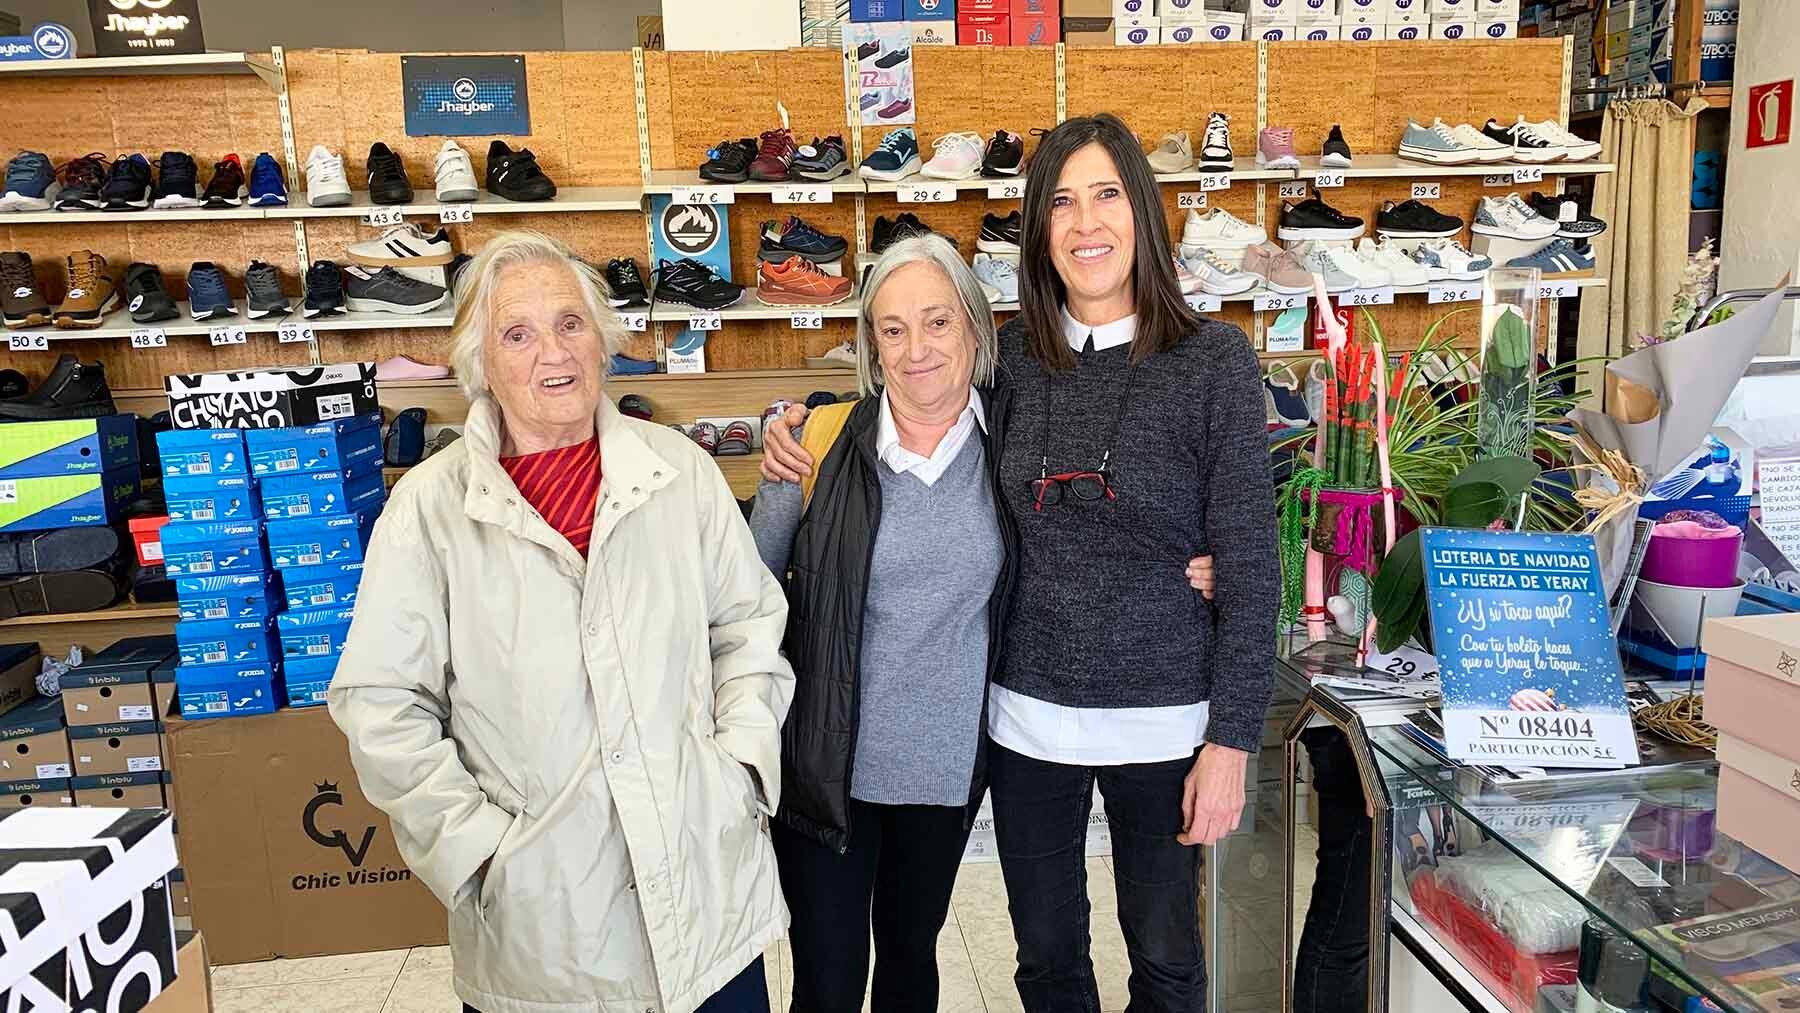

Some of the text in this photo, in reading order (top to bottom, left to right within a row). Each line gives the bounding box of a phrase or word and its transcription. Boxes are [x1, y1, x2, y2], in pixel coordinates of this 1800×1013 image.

[437, 101, 495, 114] Jhayber
[1517, 168, 1541, 180] 24 €
[1203, 175, 1228, 188] 25 €
[1318, 175, 1343, 185] 20 €
[913, 191, 941, 201] 29 €
[1004, 187, 1018, 197] 29
[1280, 187, 1304, 196] 24 €
[1413, 186, 1438, 196] 29 €
[690, 193, 718, 203] 47 €
[788, 192, 816, 202] 47 €
[1180, 195, 1205, 205] 26 €
[374, 212, 401, 223] 43 €
[443, 210, 470, 221] 43 €
[1443, 290, 1467, 301] 29 €
[1540, 287, 1564, 297] 29 €
[1268, 298, 1294, 309] 29 €
[1354, 294, 1380, 304] 26 €
[692, 318, 719, 328] 72 €
[794, 317, 820, 327] 52 €
[135, 334, 163, 346] 48 €
[214, 331, 244, 343] 41 €
[281, 329, 310, 341] 39 €
[12, 336, 45, 347] 50 €
[1433, 550, 1590, 569] LOTERIA DE NAVIDAD
[1440, 572, 1588, 590] LA FUERZA DE YERAY
[1488, 600, 1501, 621] si
[1499, 599, 1533, 620] toca
[1460, 633, 1572, 655] Con tu boleto haces
[1461, 657, 1483, 674] que
[1484, 658, 1494, 669] a
[1495, 651, 1535, 679] Yeray
[1534, 652, 1548, 670] le
[1518, 716, 1594, 738] 08404
[1468, 742, 1590, 758] PARTICIPACIÓN
[292, 866, 412, 890] Chic Vision
